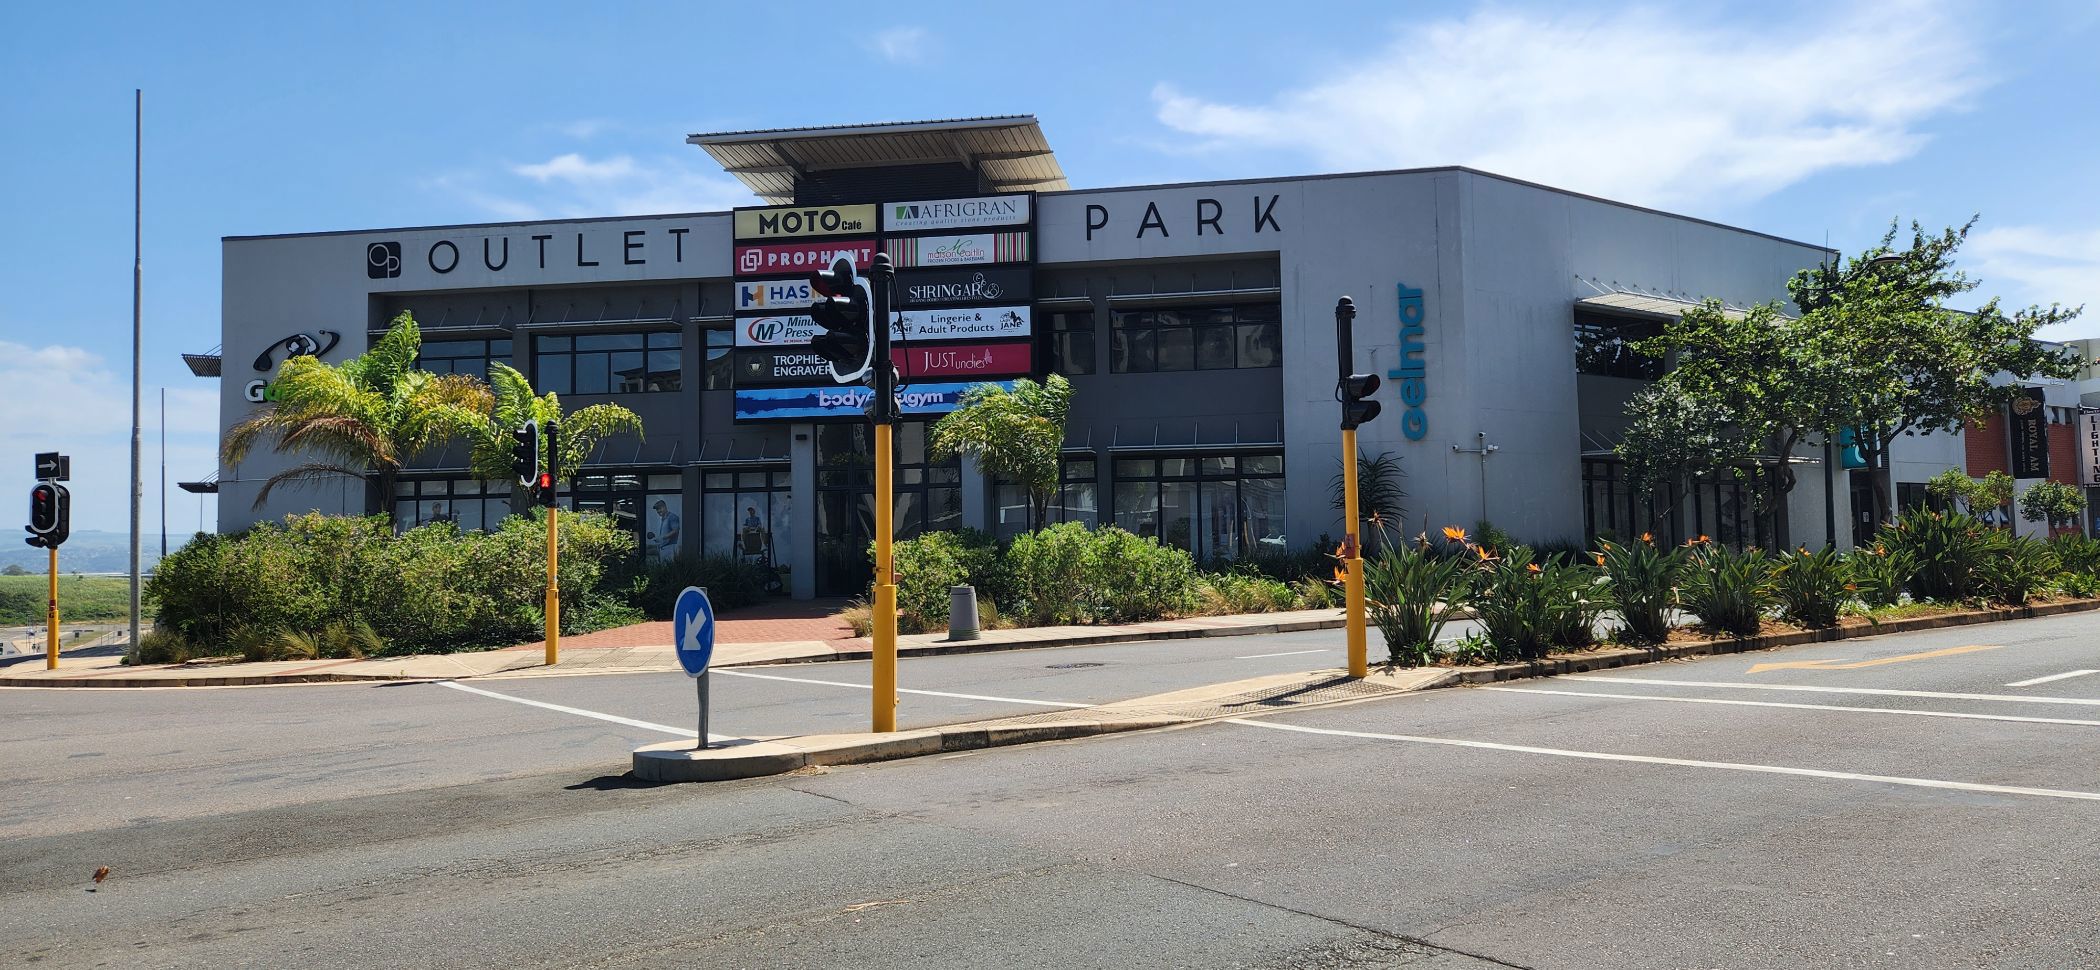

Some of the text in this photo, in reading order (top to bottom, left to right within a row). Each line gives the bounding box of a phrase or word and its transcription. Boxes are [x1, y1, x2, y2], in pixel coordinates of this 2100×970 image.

[921, 200, 1016, 219] AFRIGRAN
[1085, 194, 1281, 241] PARK
[759, 209, 862, 235] MOTO Café
[427, 228, 690, 275] OUTLET
[908, 282, 983, 299] SHRINGAR
[930, 312, 982, 325] Lingerie &
[784, 328, 814, 338] Press
[919, 324, 995, 335] Adult Products
[923, 351, 986, 374] JUST undies
[2028, 419, 2040, 472] ROYAL AM
